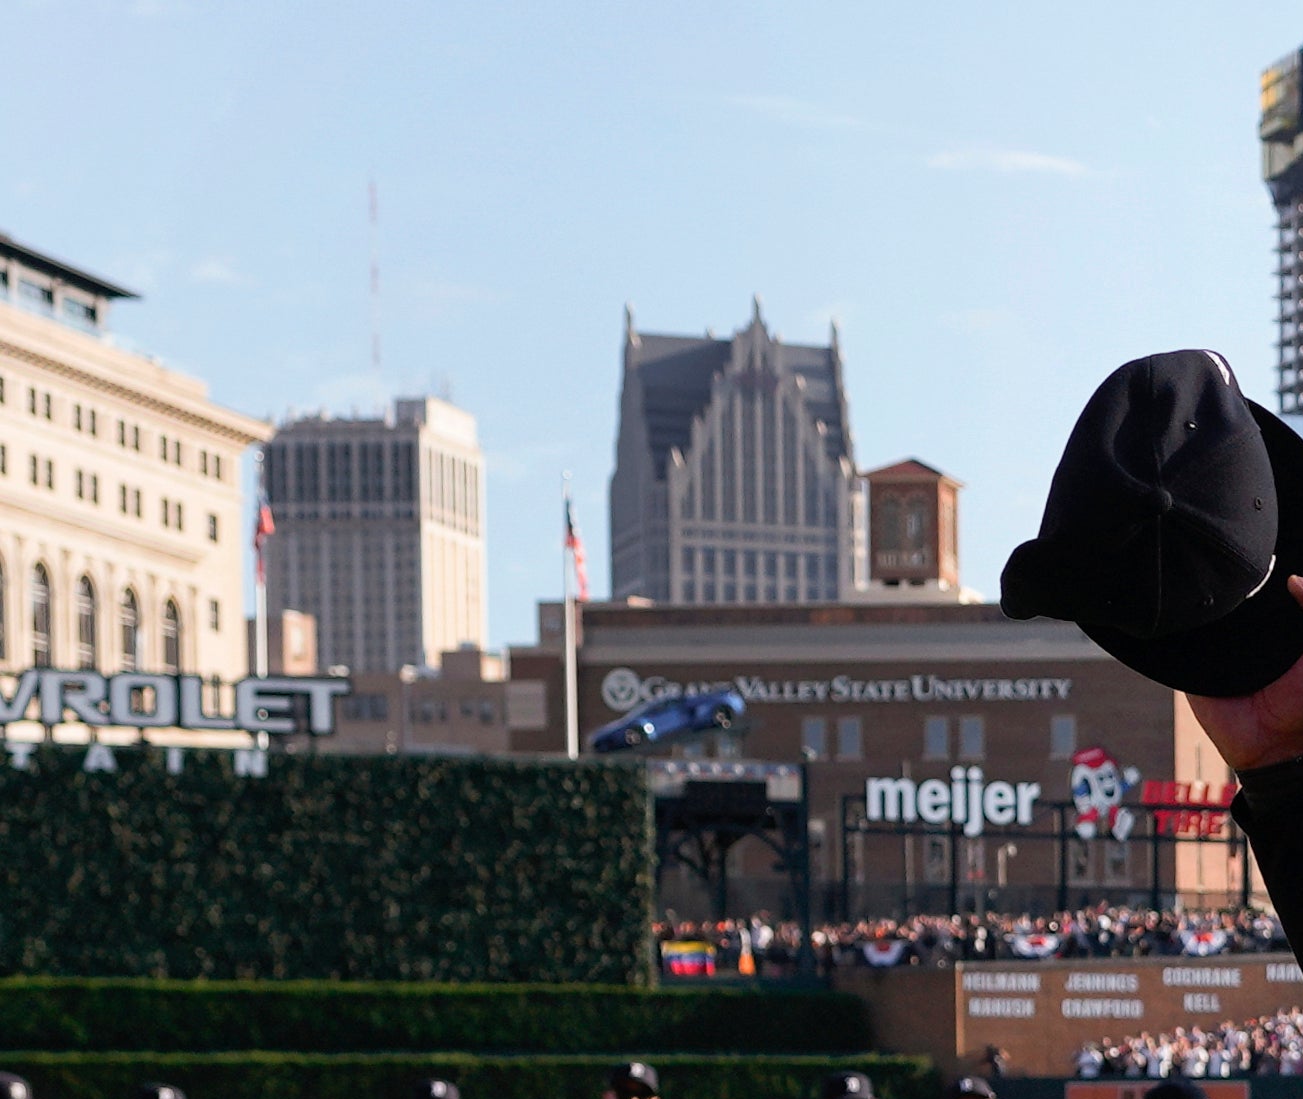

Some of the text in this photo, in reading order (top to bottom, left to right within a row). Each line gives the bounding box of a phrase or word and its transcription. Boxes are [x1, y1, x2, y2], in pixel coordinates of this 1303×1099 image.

[734, 676, 827, 701] VALLEY
[831, 675, 909, 700] STATE
[911, 674, 1071, 700] UNIVERSITY
[866, 765, 1041, 838] meijer
